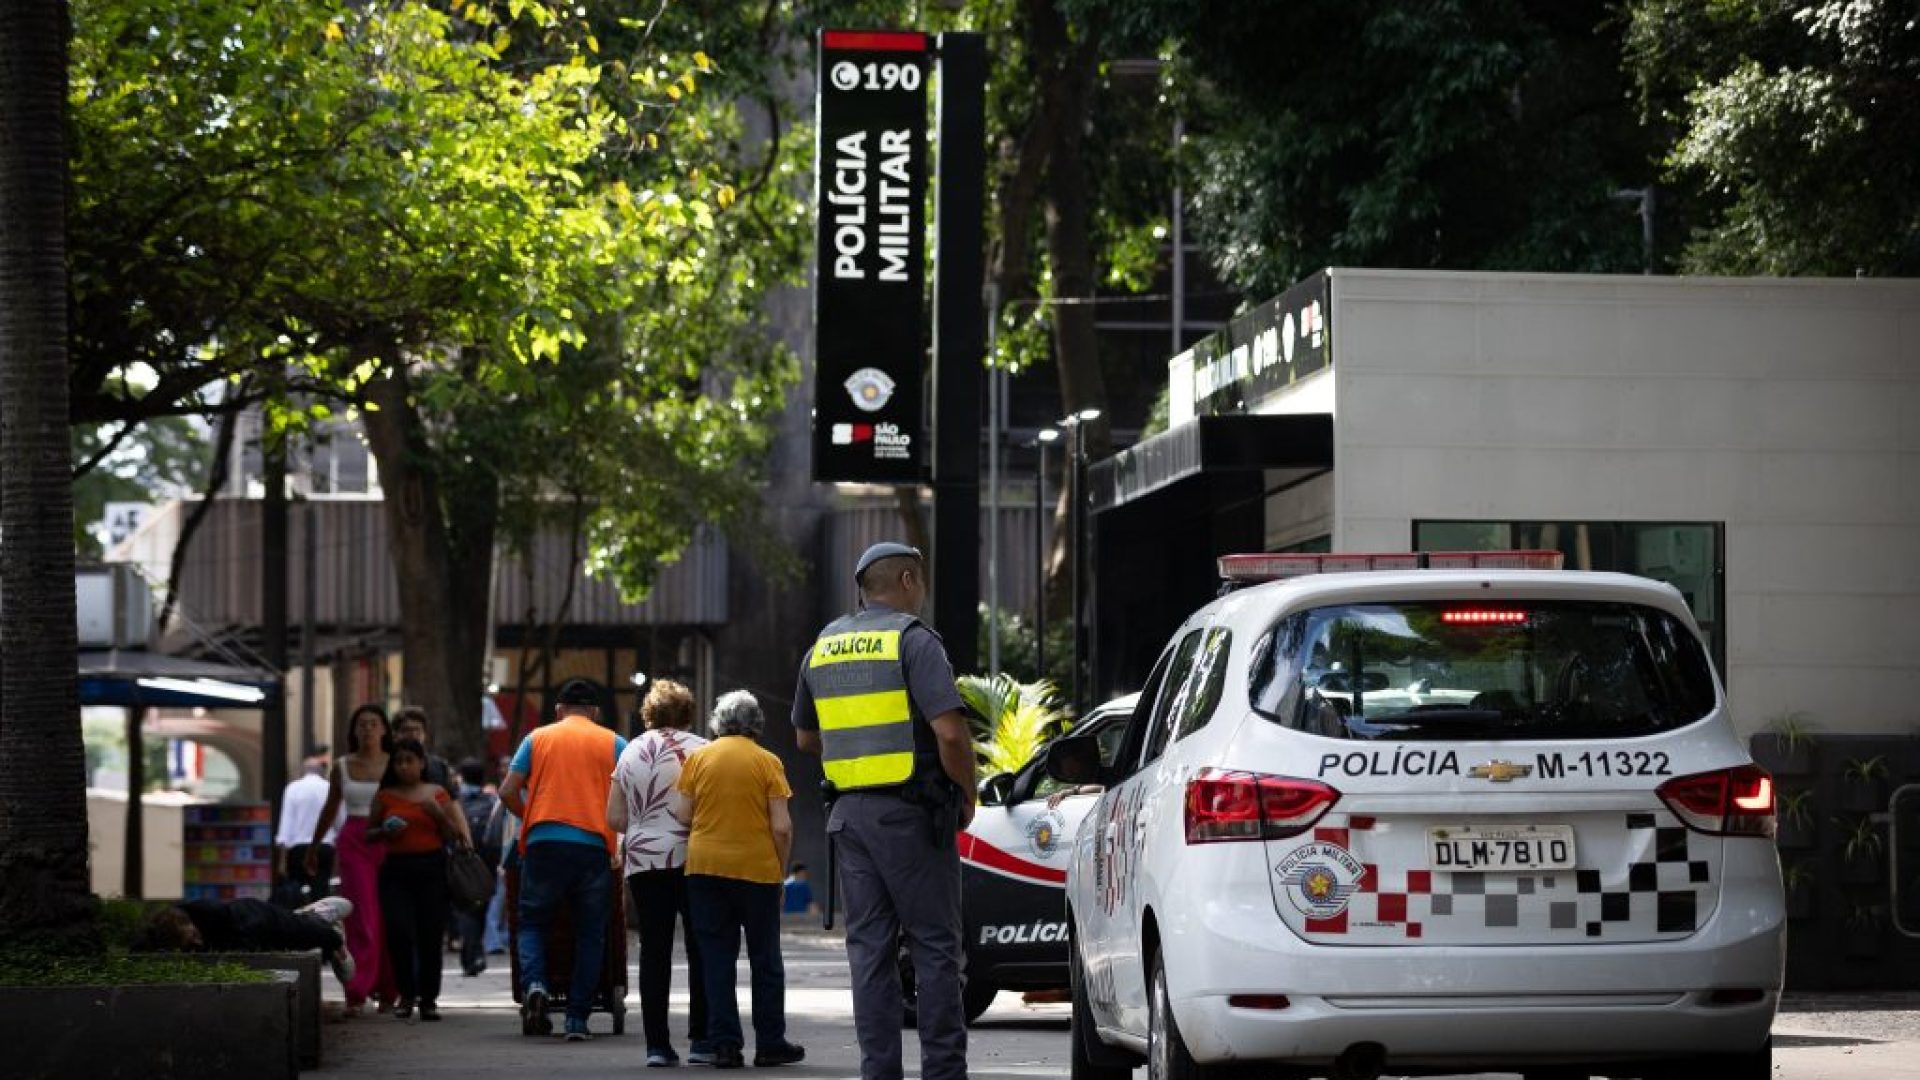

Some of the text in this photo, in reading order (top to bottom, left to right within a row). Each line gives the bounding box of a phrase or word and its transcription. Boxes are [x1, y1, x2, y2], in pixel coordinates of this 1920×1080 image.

[863, 62, 921, 91] 190
[828, 130, 867, 279] POLÍCIA
[878, 128, 911, 282] MILITAR
[1318, 745, 1460, 777] POLÍCIA
[1536, 751, 1672, 778] M-11322
